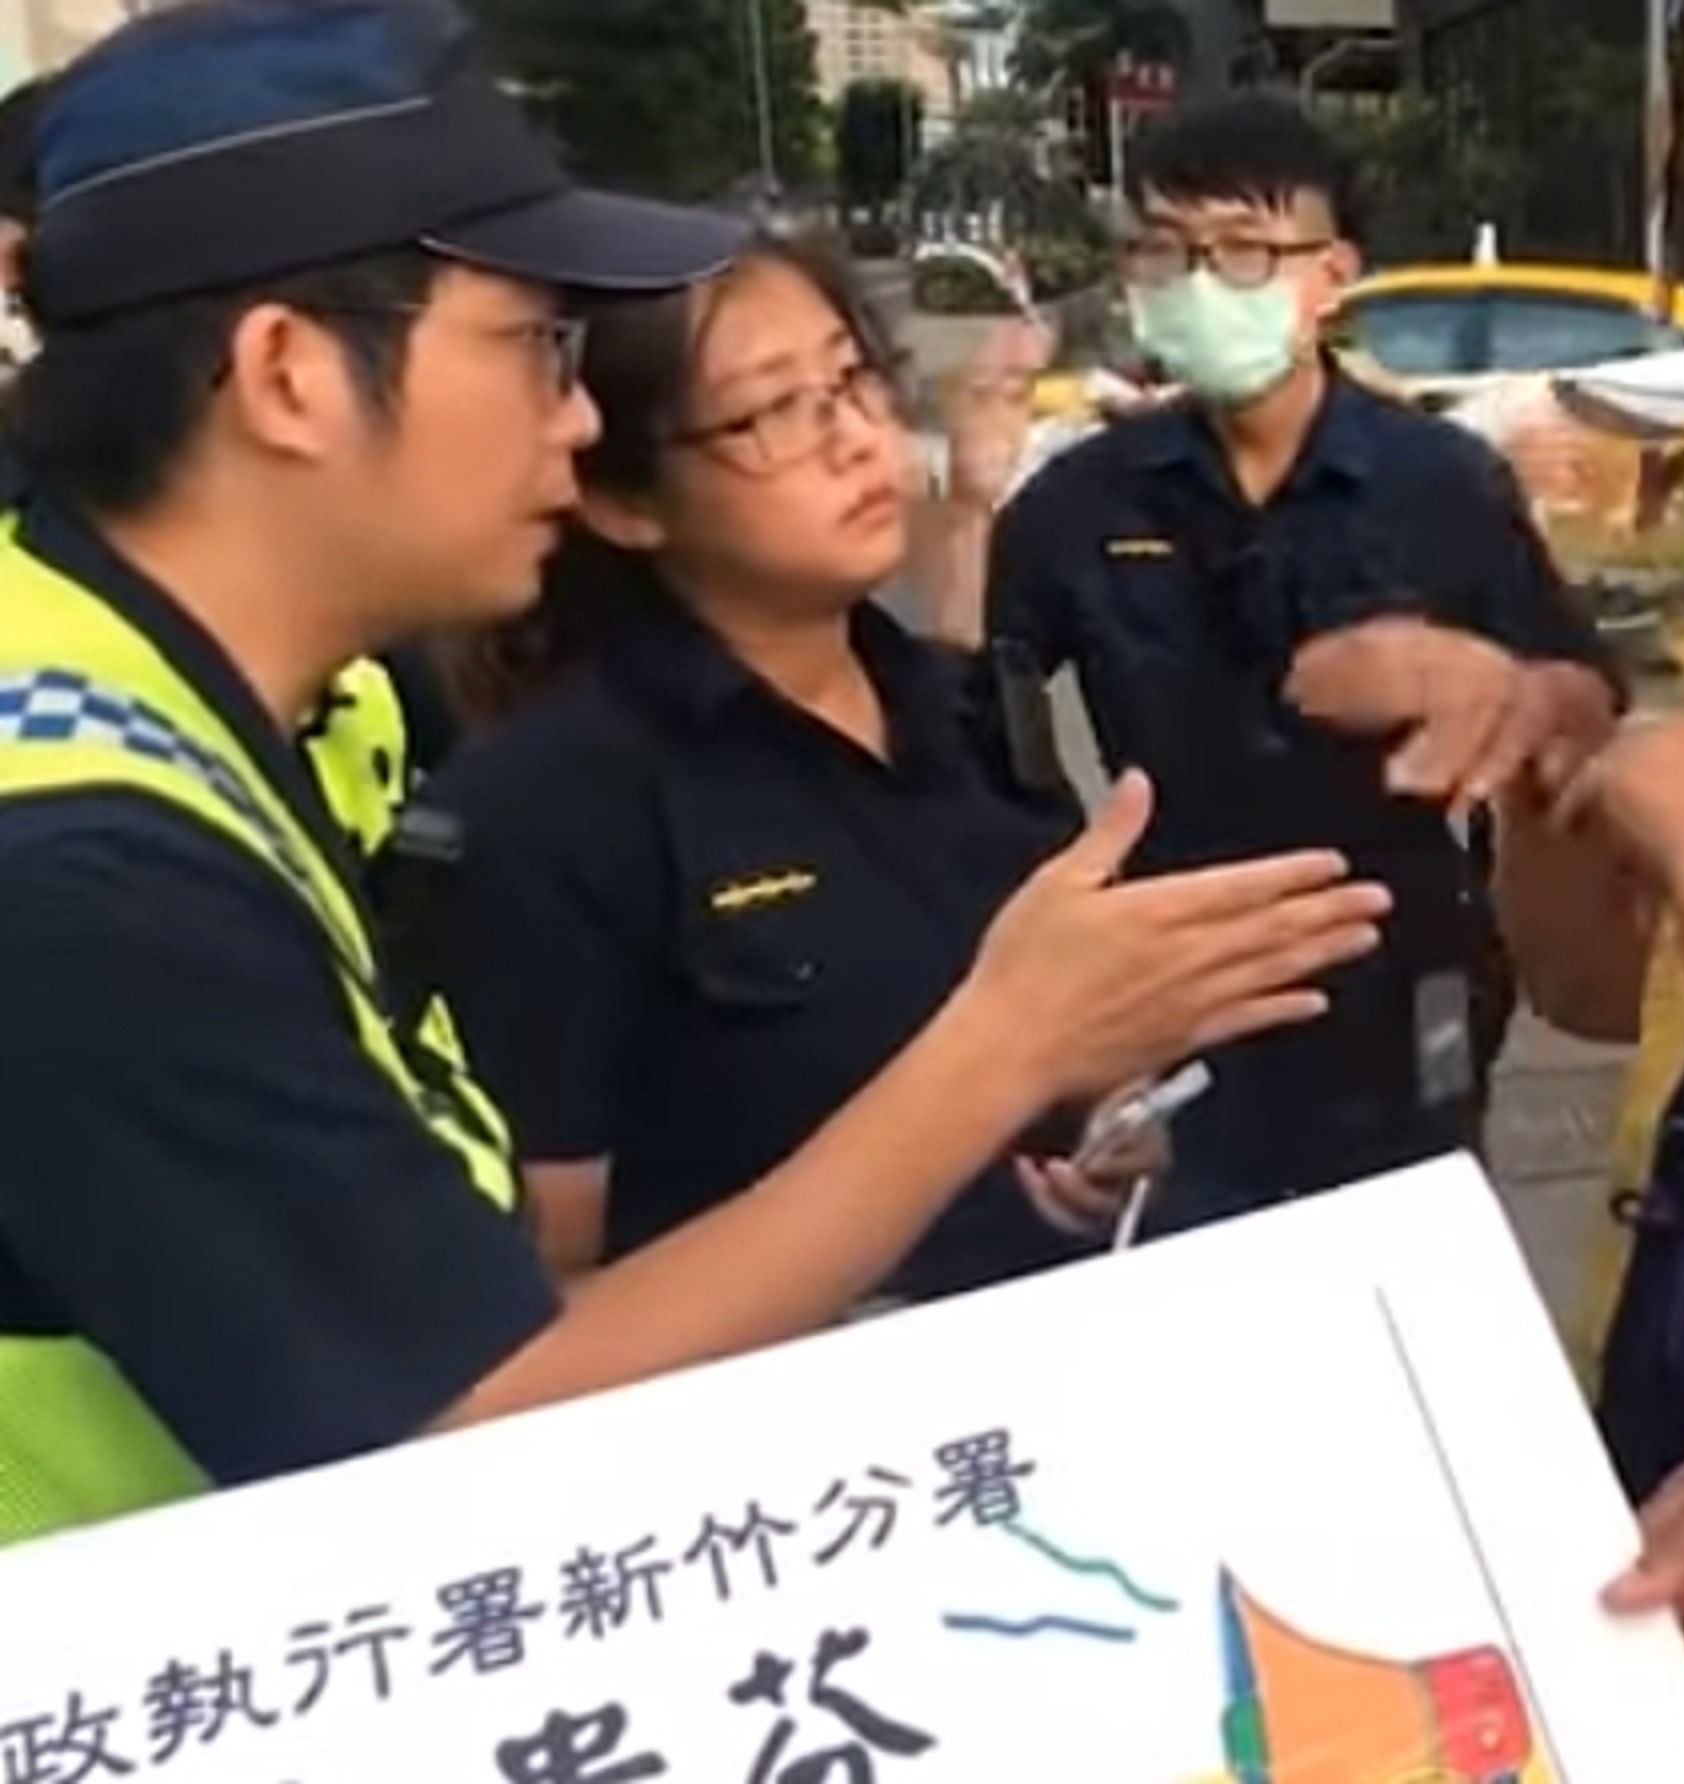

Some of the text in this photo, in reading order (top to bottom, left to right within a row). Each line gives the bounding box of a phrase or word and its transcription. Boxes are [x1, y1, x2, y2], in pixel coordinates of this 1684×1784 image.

[0, 1429, 1037, 1784] 政執行署新竹分署
